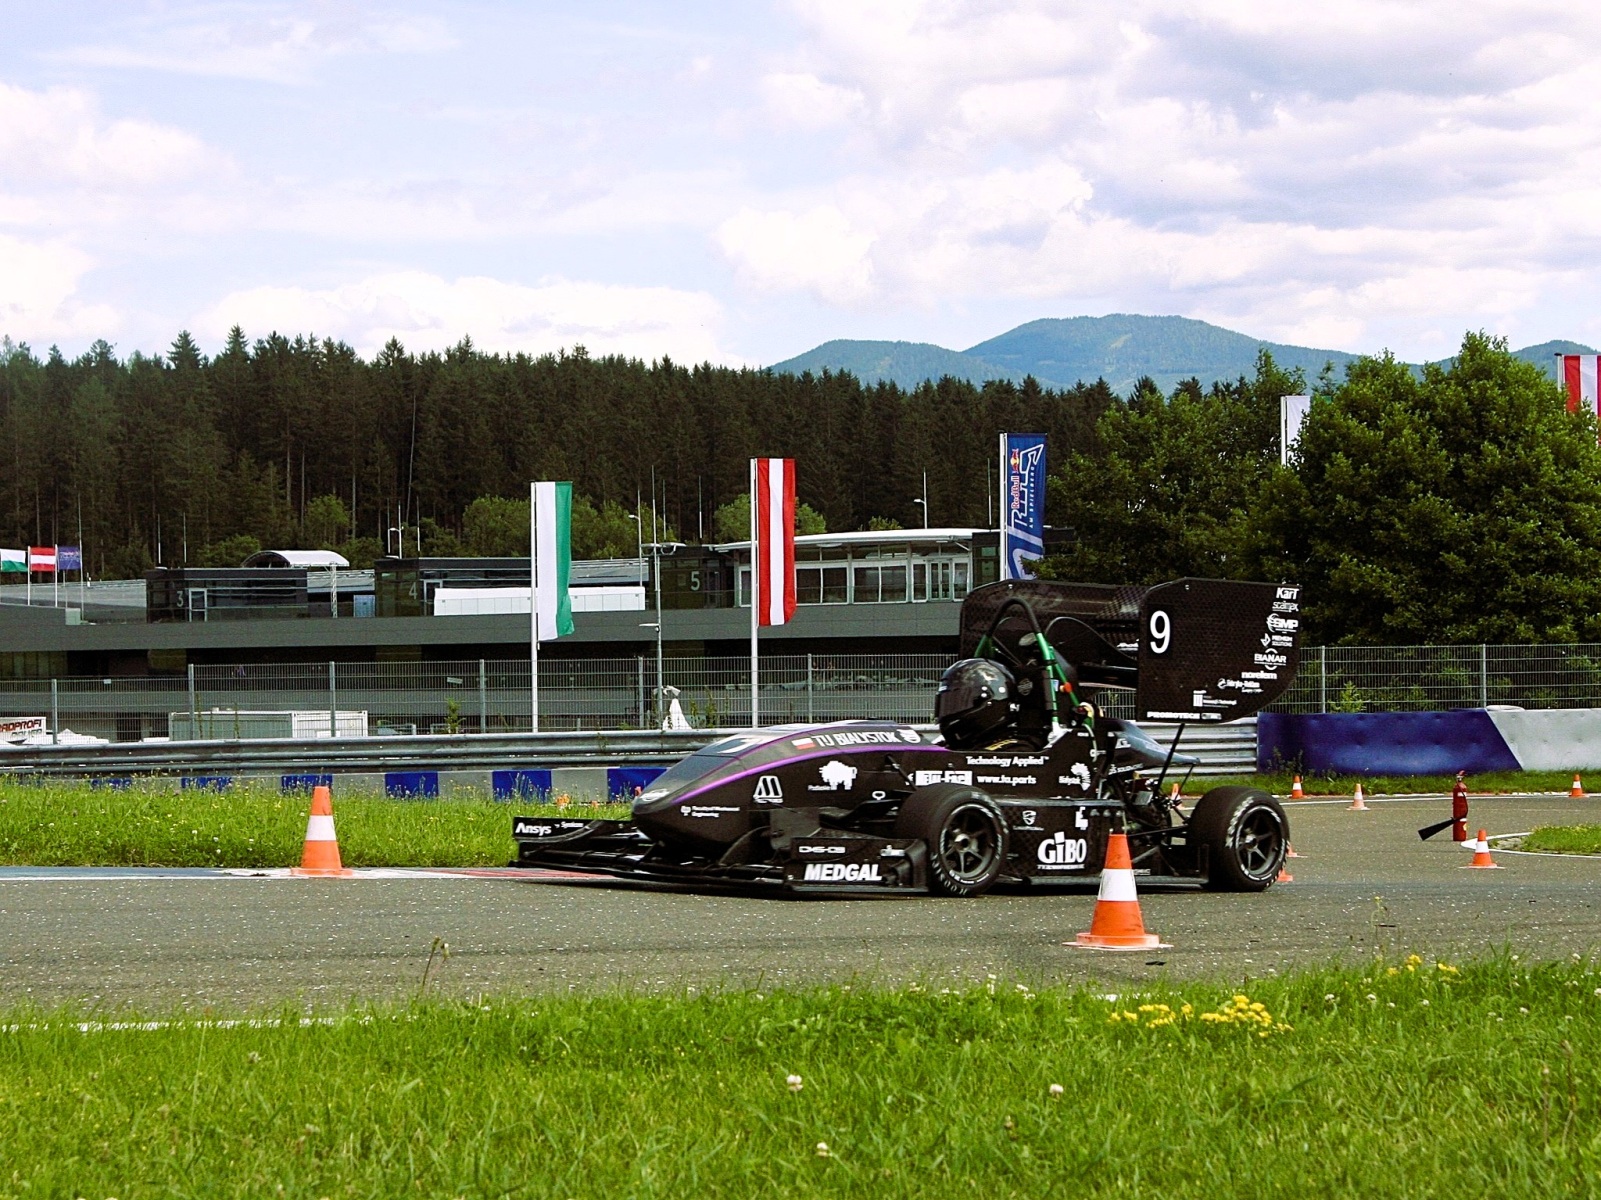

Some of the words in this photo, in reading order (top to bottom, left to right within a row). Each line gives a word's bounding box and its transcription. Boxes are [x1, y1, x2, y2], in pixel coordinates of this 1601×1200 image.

[690, 570, 700, 591] 5
[176, 590, 184, 608] 3
[408, 581, 418, 600] 4
[1150, 610, 1171, 654] 9
[811, 735, 836, 747] TU
[965, 756, 1012, 767] Technology
[514, 822, 552, 837] Ansys
[803, 863, 883, 882] MEDGAL
